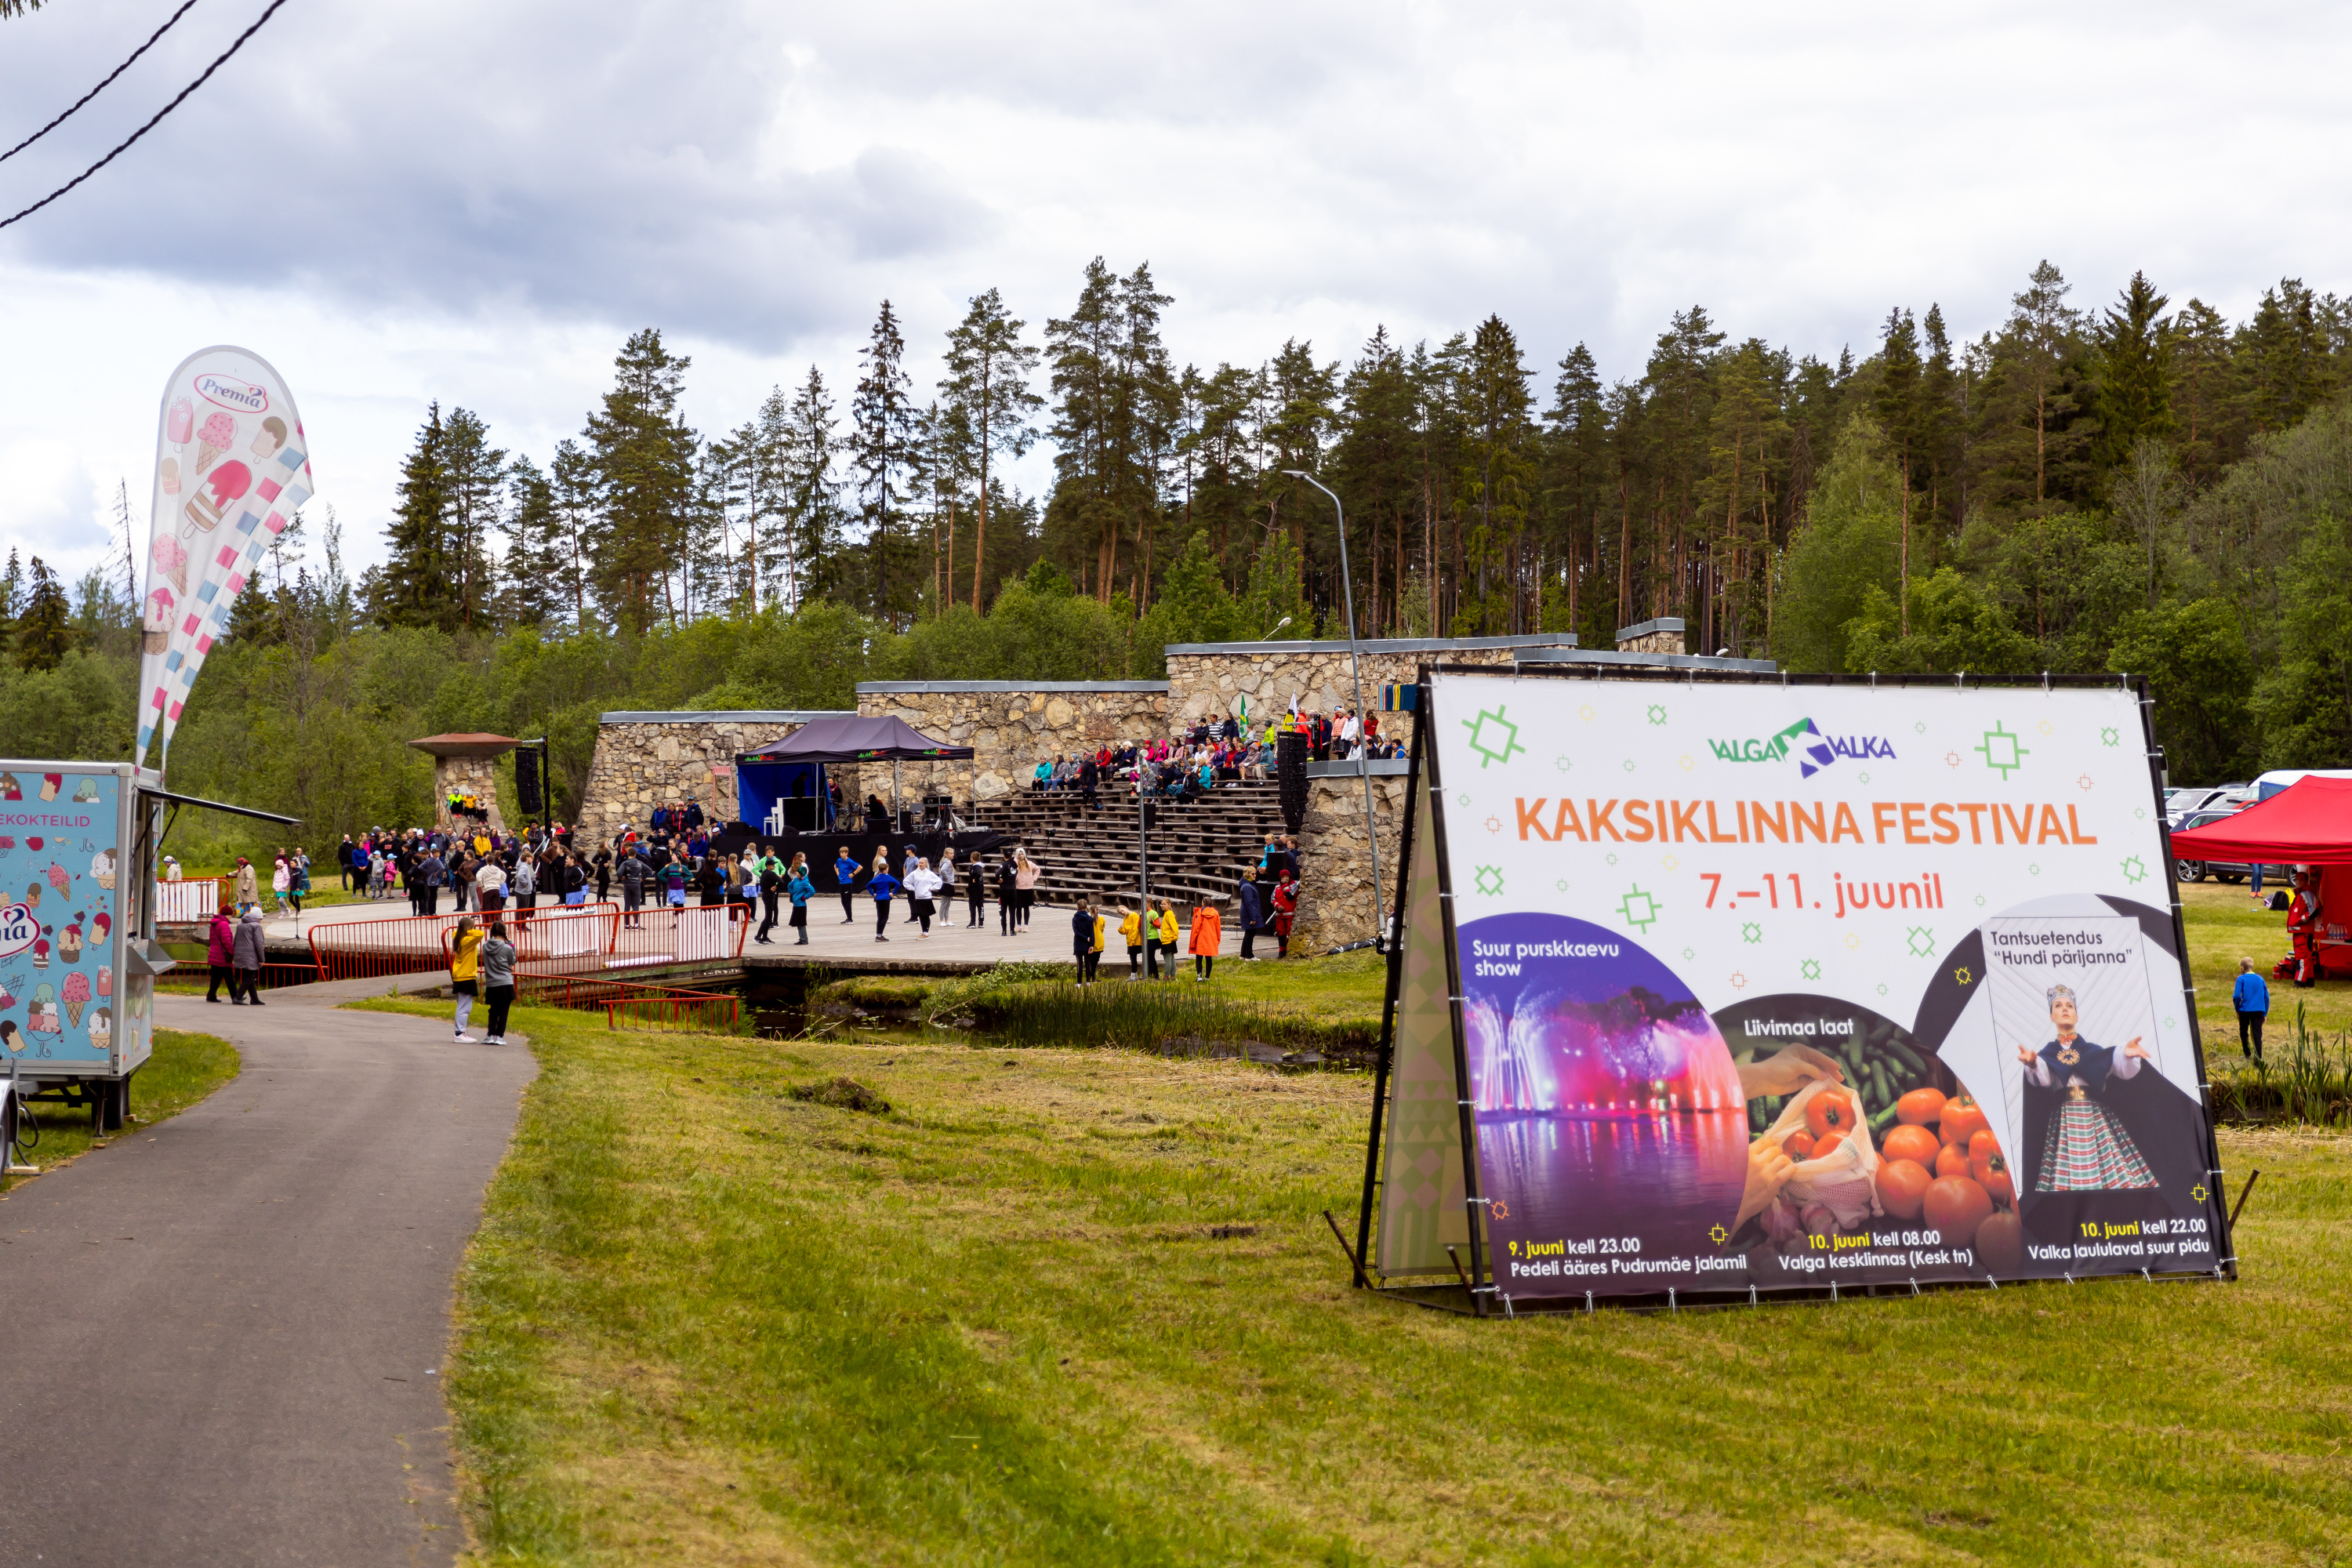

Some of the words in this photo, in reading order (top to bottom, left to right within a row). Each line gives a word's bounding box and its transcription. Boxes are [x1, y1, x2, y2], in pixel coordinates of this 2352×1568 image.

[201, 379, 260, 408] Premia
[1708, 739, 1782, 762] VALGA
[1825, 735, 1897, 759] VALKA
[1515, 797, 1865, 844] KAKSIKLINNA
[1871, 800, 2098, 845] FESTIVAL
[1833, 871, 1944, 918] juunil
[1991, 931, 2103, 946] Tantsuetendus
[1472, 939, 1514, 957] Suur
[1516, 940, 1620, 960] purskkaevu
[1475, 960, 1522, 976] show
[1744, 1018, 1817, 1036] Liivimaa
[1820, 1018, 1854, 1035] laat
[2081, 1222, 2102, 1237] 10.
[2104, 1221, 2140, 1240] juuni
[2142, 1220, 2167, 1235] kell
[2170, 1218, 2207, 1233] 22.00
[1509, 1241, 1523, 1256] 9.
[1526, 1240, 1564, 1259] juuni
[1568, 1239, 1595, 1254] kell
[1599, 1238, 1640, 1254] 23.00
[1808, 1234, 1830, 1249] 10.
[1833, 1232, 1870, 1251] juuni
[1873, 1232, 1899, 1247] kell
[1902, 1230, 1940, 1246] 08.00
[2028, 1245, 2071, 1260] Valka
[2074, 1241, 2144, 1258] laululaval
[2147, 1242, 2176, 1254] suur
[2179, 1239, 2210, 1256] pidu
[1511, 1259, 1559, 1277] Pedeli
[1563, 1260, 1608, 1276] ääres
[1611, 1256, 1691, 1273] Pudrumäe
[1695, 1254, 1747, 1274] jalamil
[1779, 1254, 1825, 1272] Valga
[1829, 1252, 1907, 1269] kesklinnas
[1910, 1250, 1950, 1269] (Kesk
[1952, 1248, 1973, 1267] tn)
